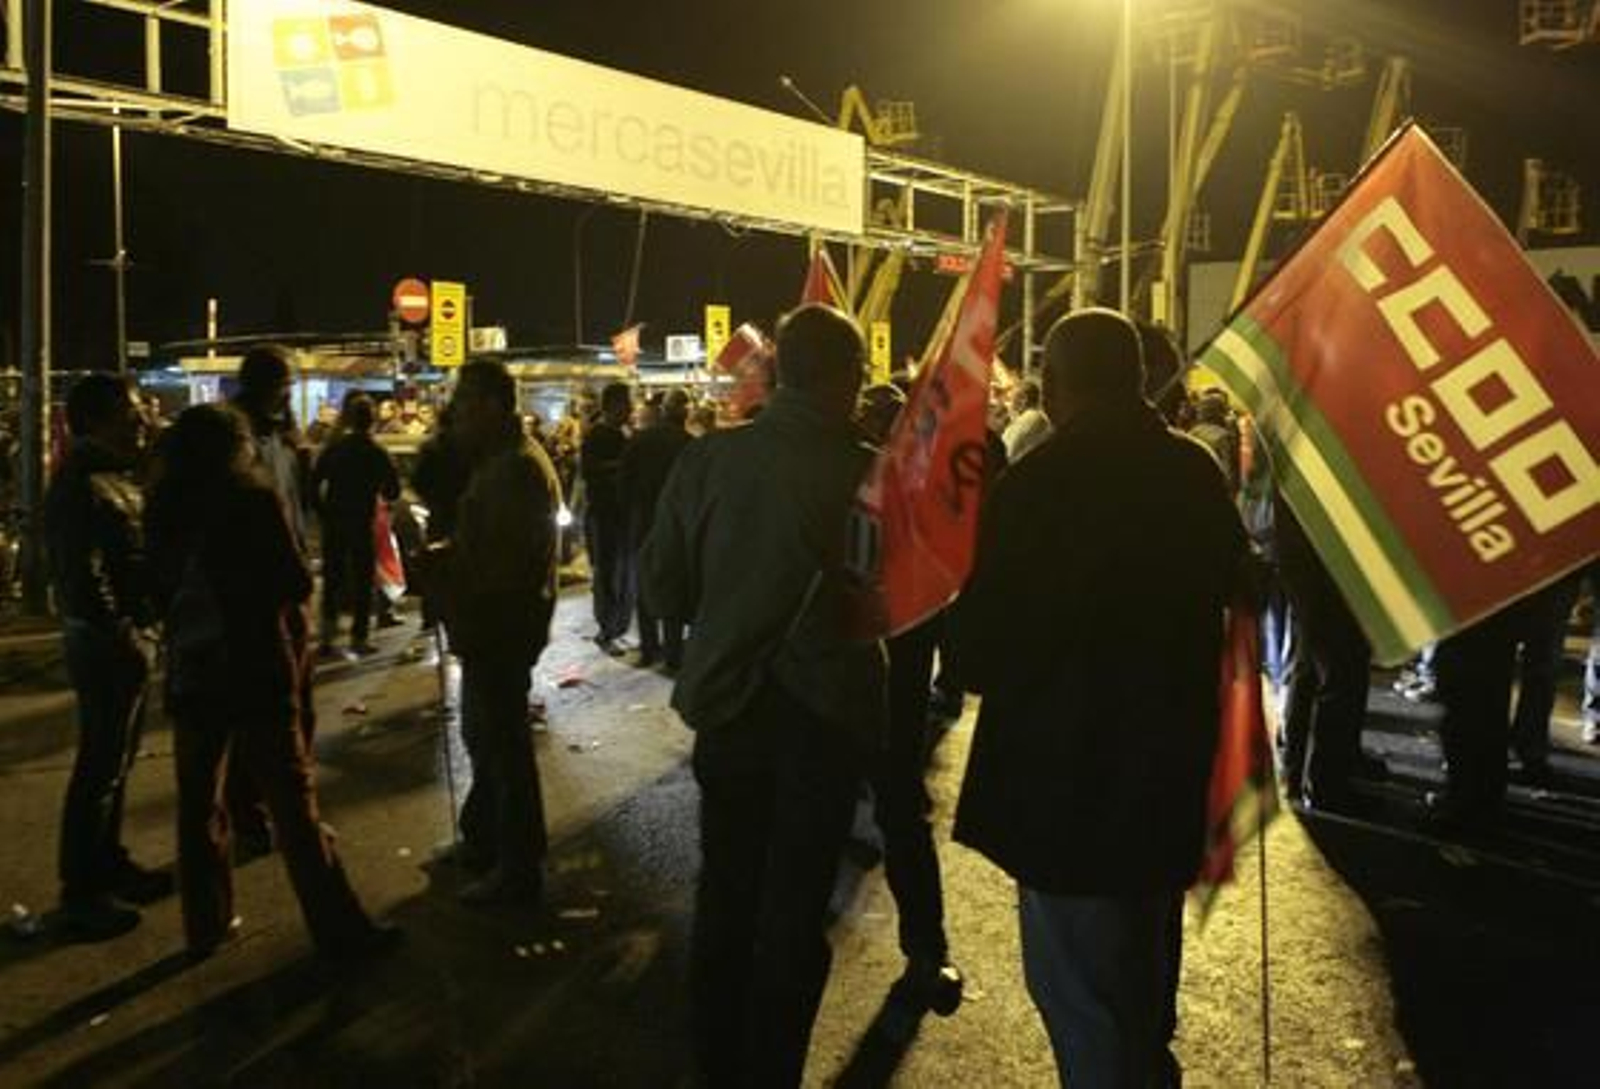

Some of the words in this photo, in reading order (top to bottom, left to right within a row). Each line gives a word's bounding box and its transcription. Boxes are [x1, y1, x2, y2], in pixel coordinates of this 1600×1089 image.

[470, 78, 850, 207] mercasevilla
[1336, 196, 1600, 534] CCOO
[1386, 396, 1515, 563] Sevilla
